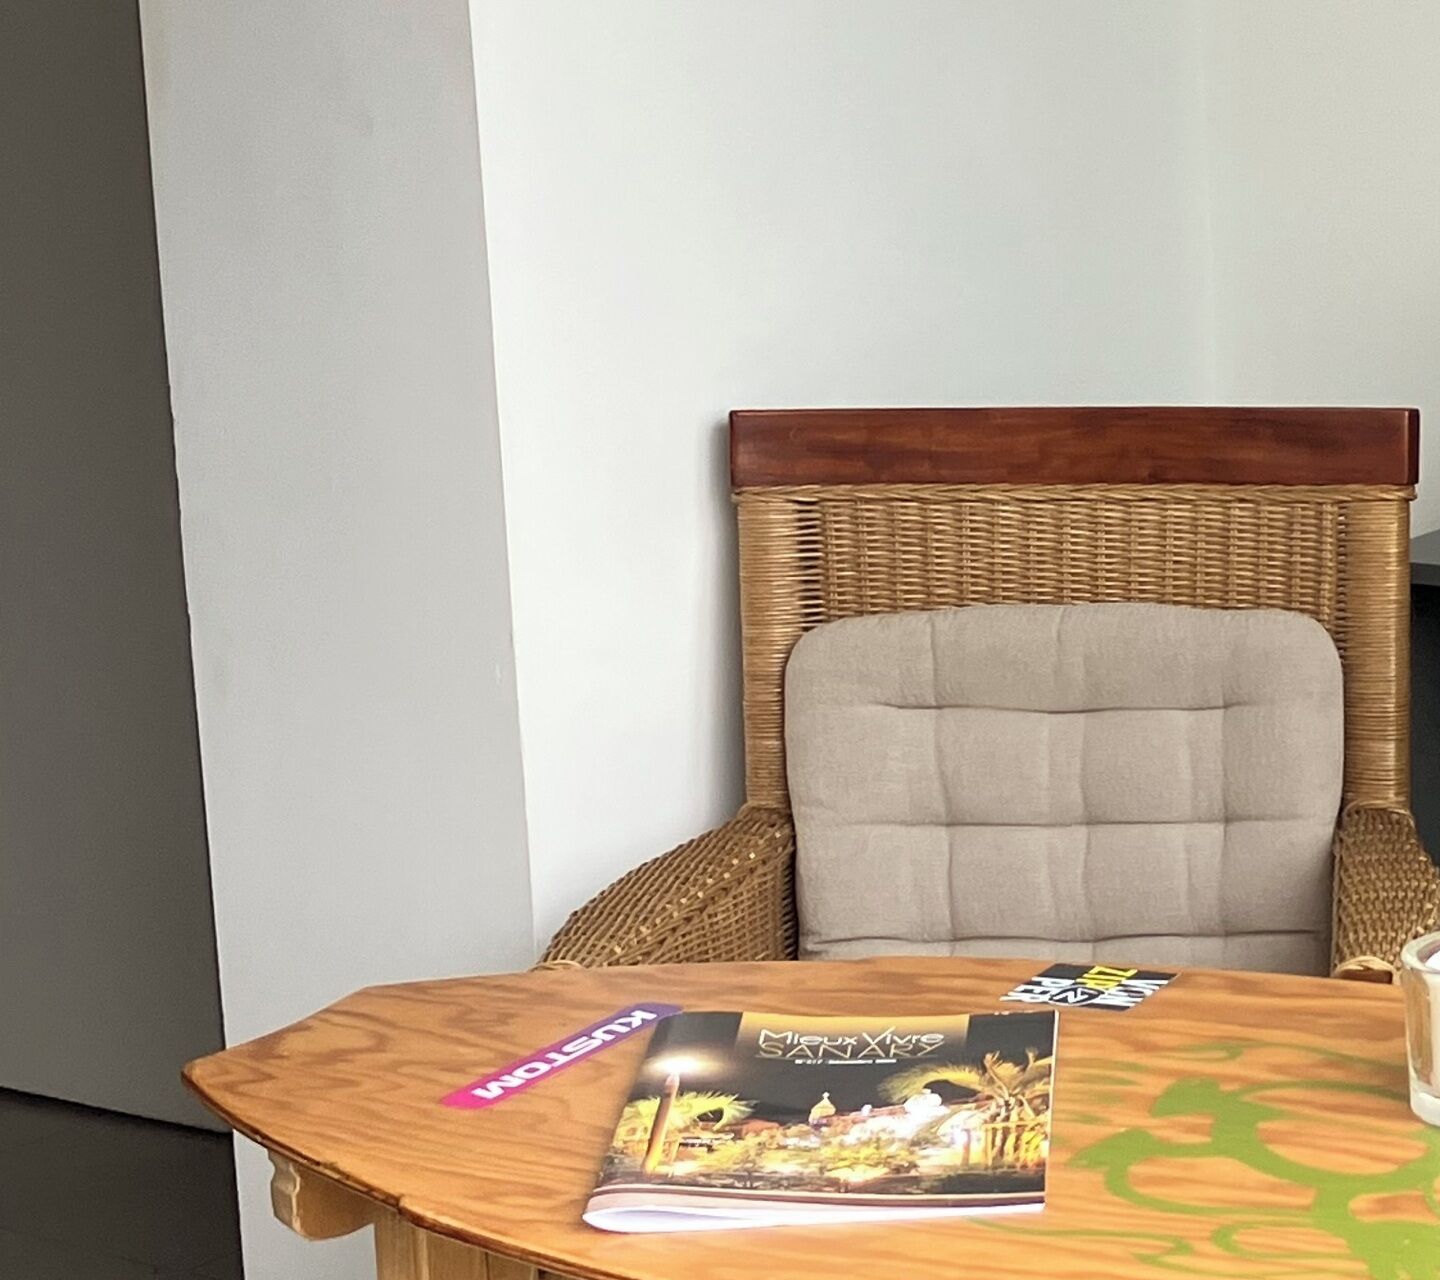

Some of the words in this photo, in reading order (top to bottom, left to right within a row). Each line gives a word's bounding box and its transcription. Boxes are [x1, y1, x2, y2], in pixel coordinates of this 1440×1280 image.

[861, 1025, 944, 1046] Vivre
[471, 1010, 657, 1099] KUSTOM
[758, 1041, 944, 1059] SANARY
